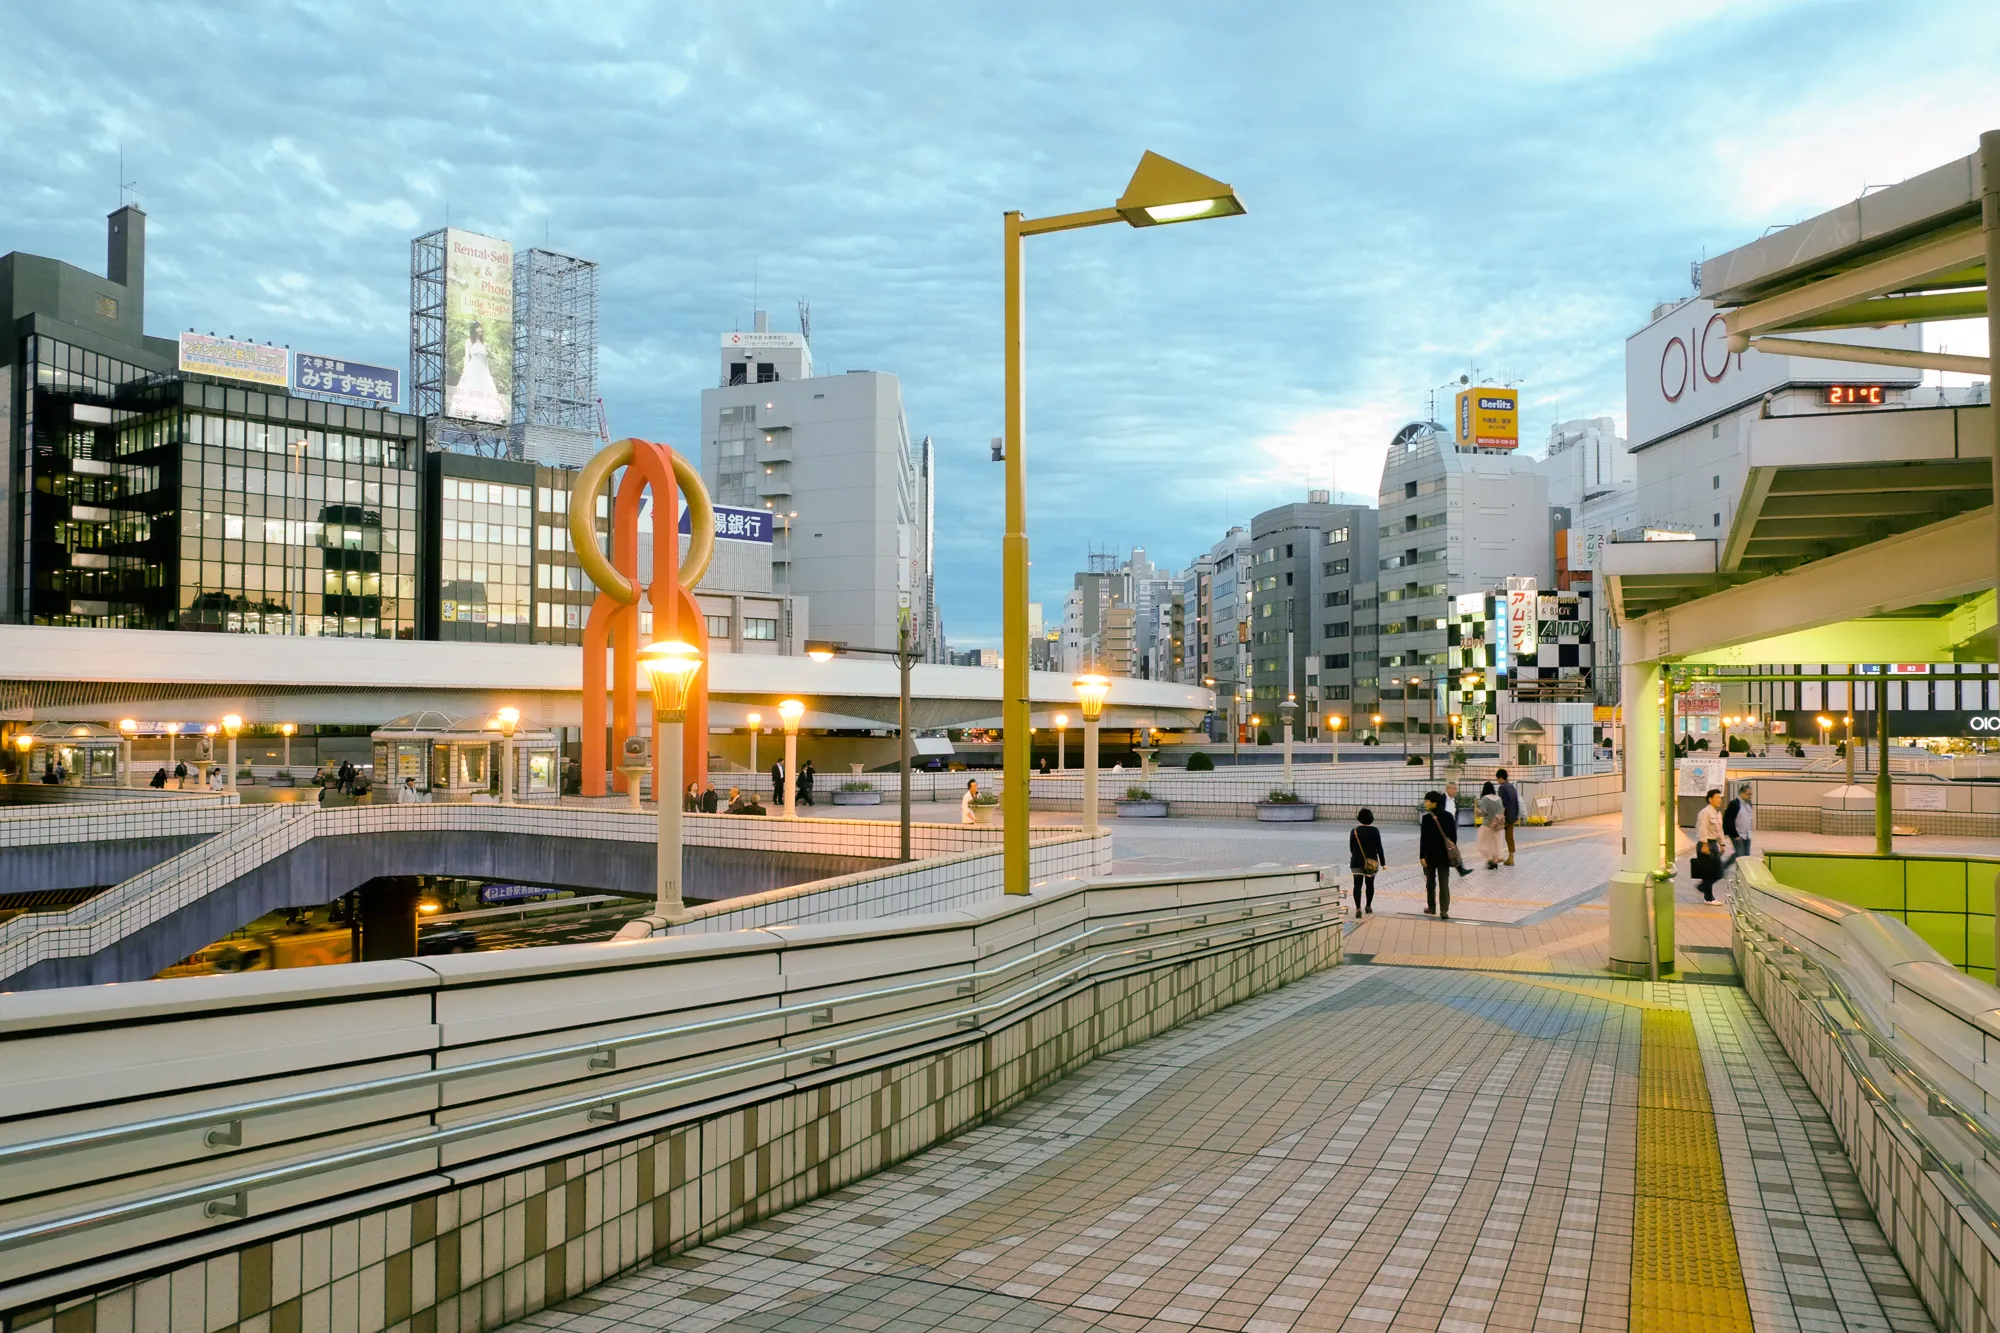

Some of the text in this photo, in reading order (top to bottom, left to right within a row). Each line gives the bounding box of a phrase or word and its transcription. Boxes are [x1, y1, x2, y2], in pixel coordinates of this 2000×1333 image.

[484, 266, 493, 277] &
[481, 280, 512, 297] Photo
[464, 297, 510, 315] Little Magic
[303, 356, 345, 372] 大学受験
[302, 368, 393, 400] みすず学苑
[1481, 399, 1512, 409] Berlitz
[1540, 595, 1583, 605] PACHINKO
[1549, 606, 1572, 616] SLOT
[1511, 592, 1526, 651] アムディ
[1540, 620, 1590, 637] AMDY
